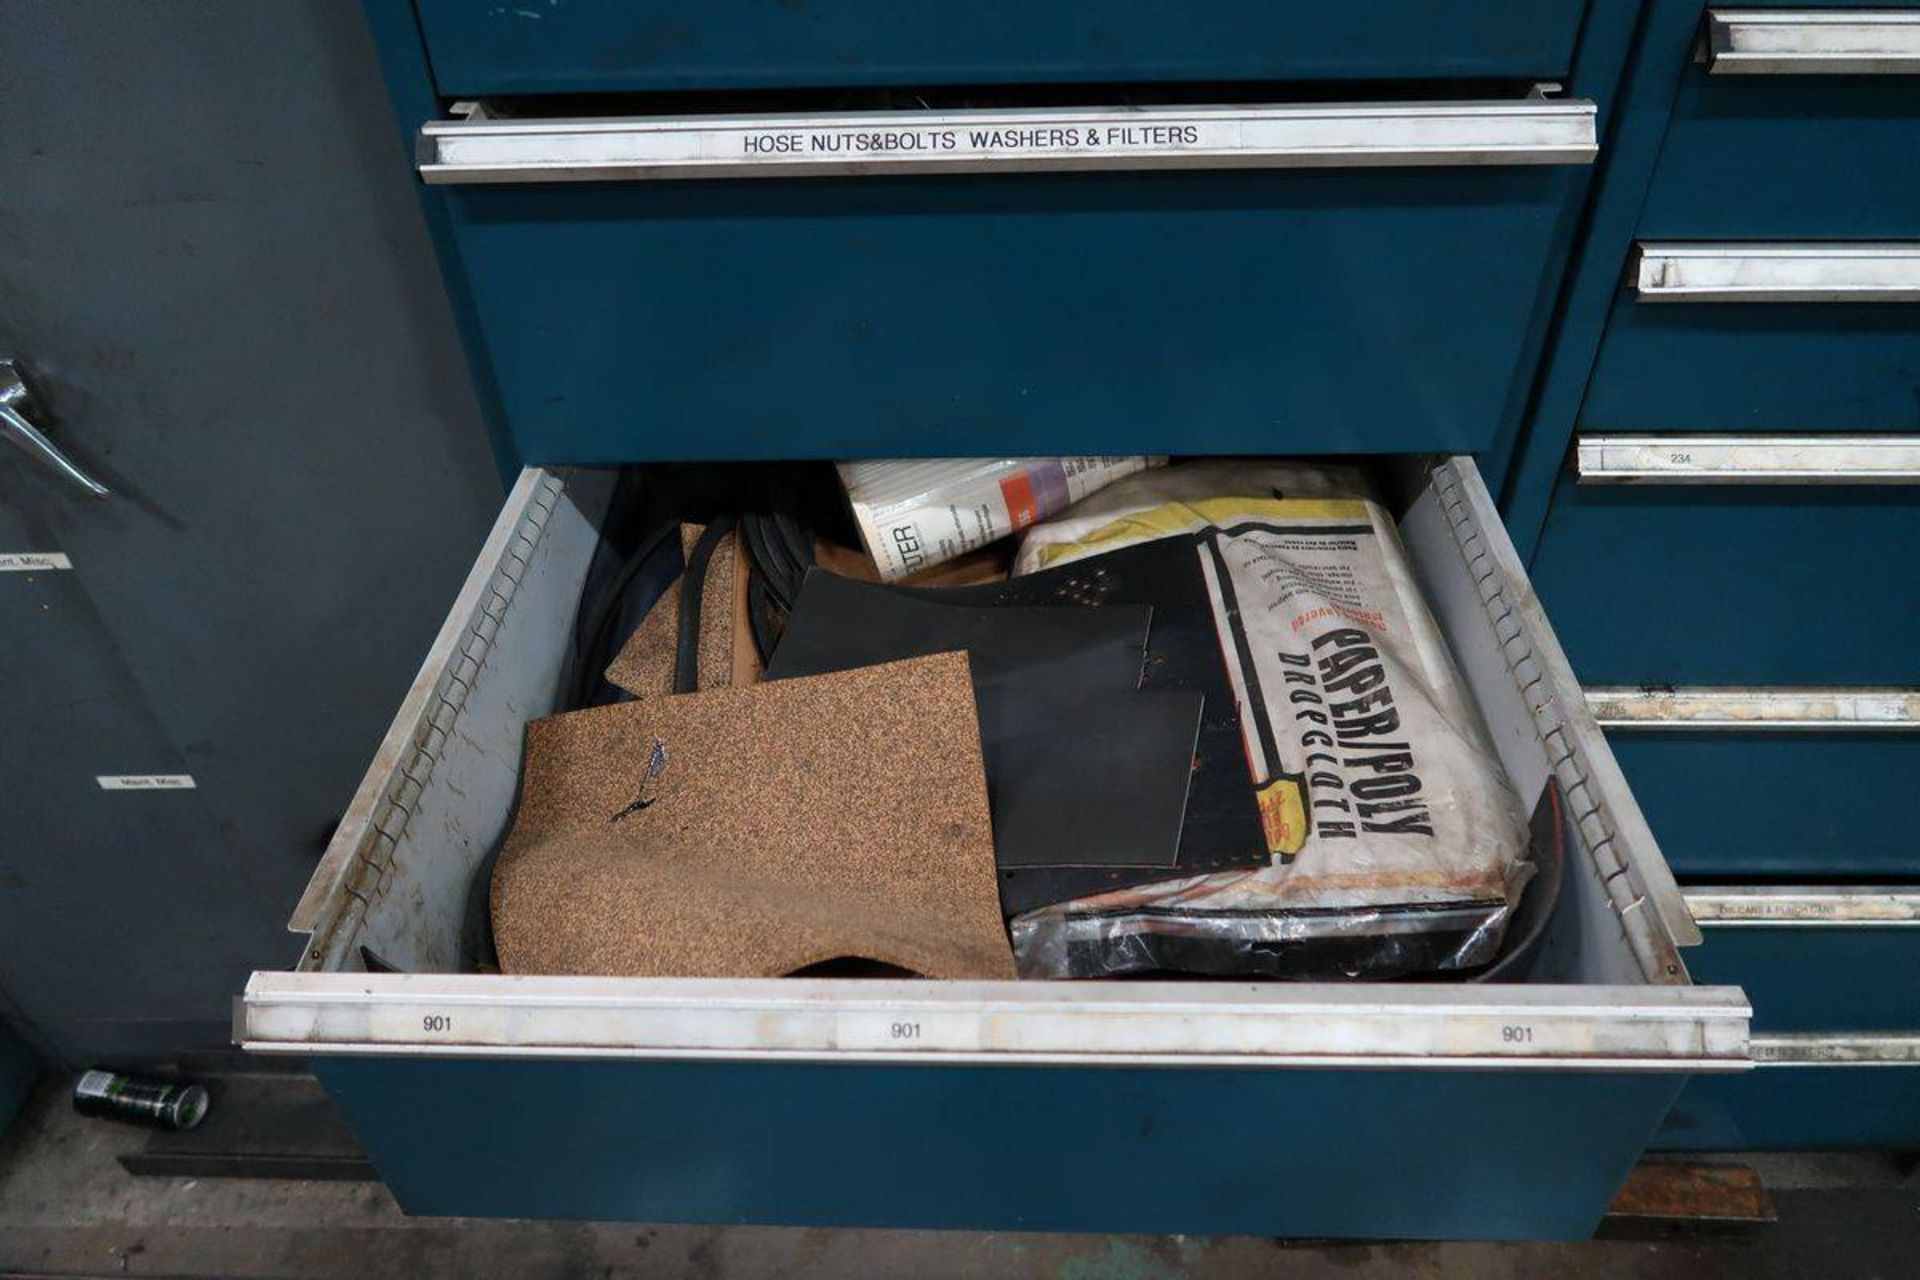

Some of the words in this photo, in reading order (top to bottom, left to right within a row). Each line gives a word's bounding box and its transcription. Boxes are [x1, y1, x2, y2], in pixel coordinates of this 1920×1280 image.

[744, 135, 804, 152] HOSE
[811, 132, 957, 151] NUTS&BOLTS
[969, 129, 1080, 148] WASHERS
[1086, 128, 1101, 146] &
[1107, 126, 1199, 145] FILTERS
[1670, 453, 1691, 465] 234
[1310, 627, 1435, 838] PAPER/POLY
[423, 1015, 451, 1032] 901
[891, 1022, 920, 1039] 901
[1502, 1025, 1532, 1043] 901
